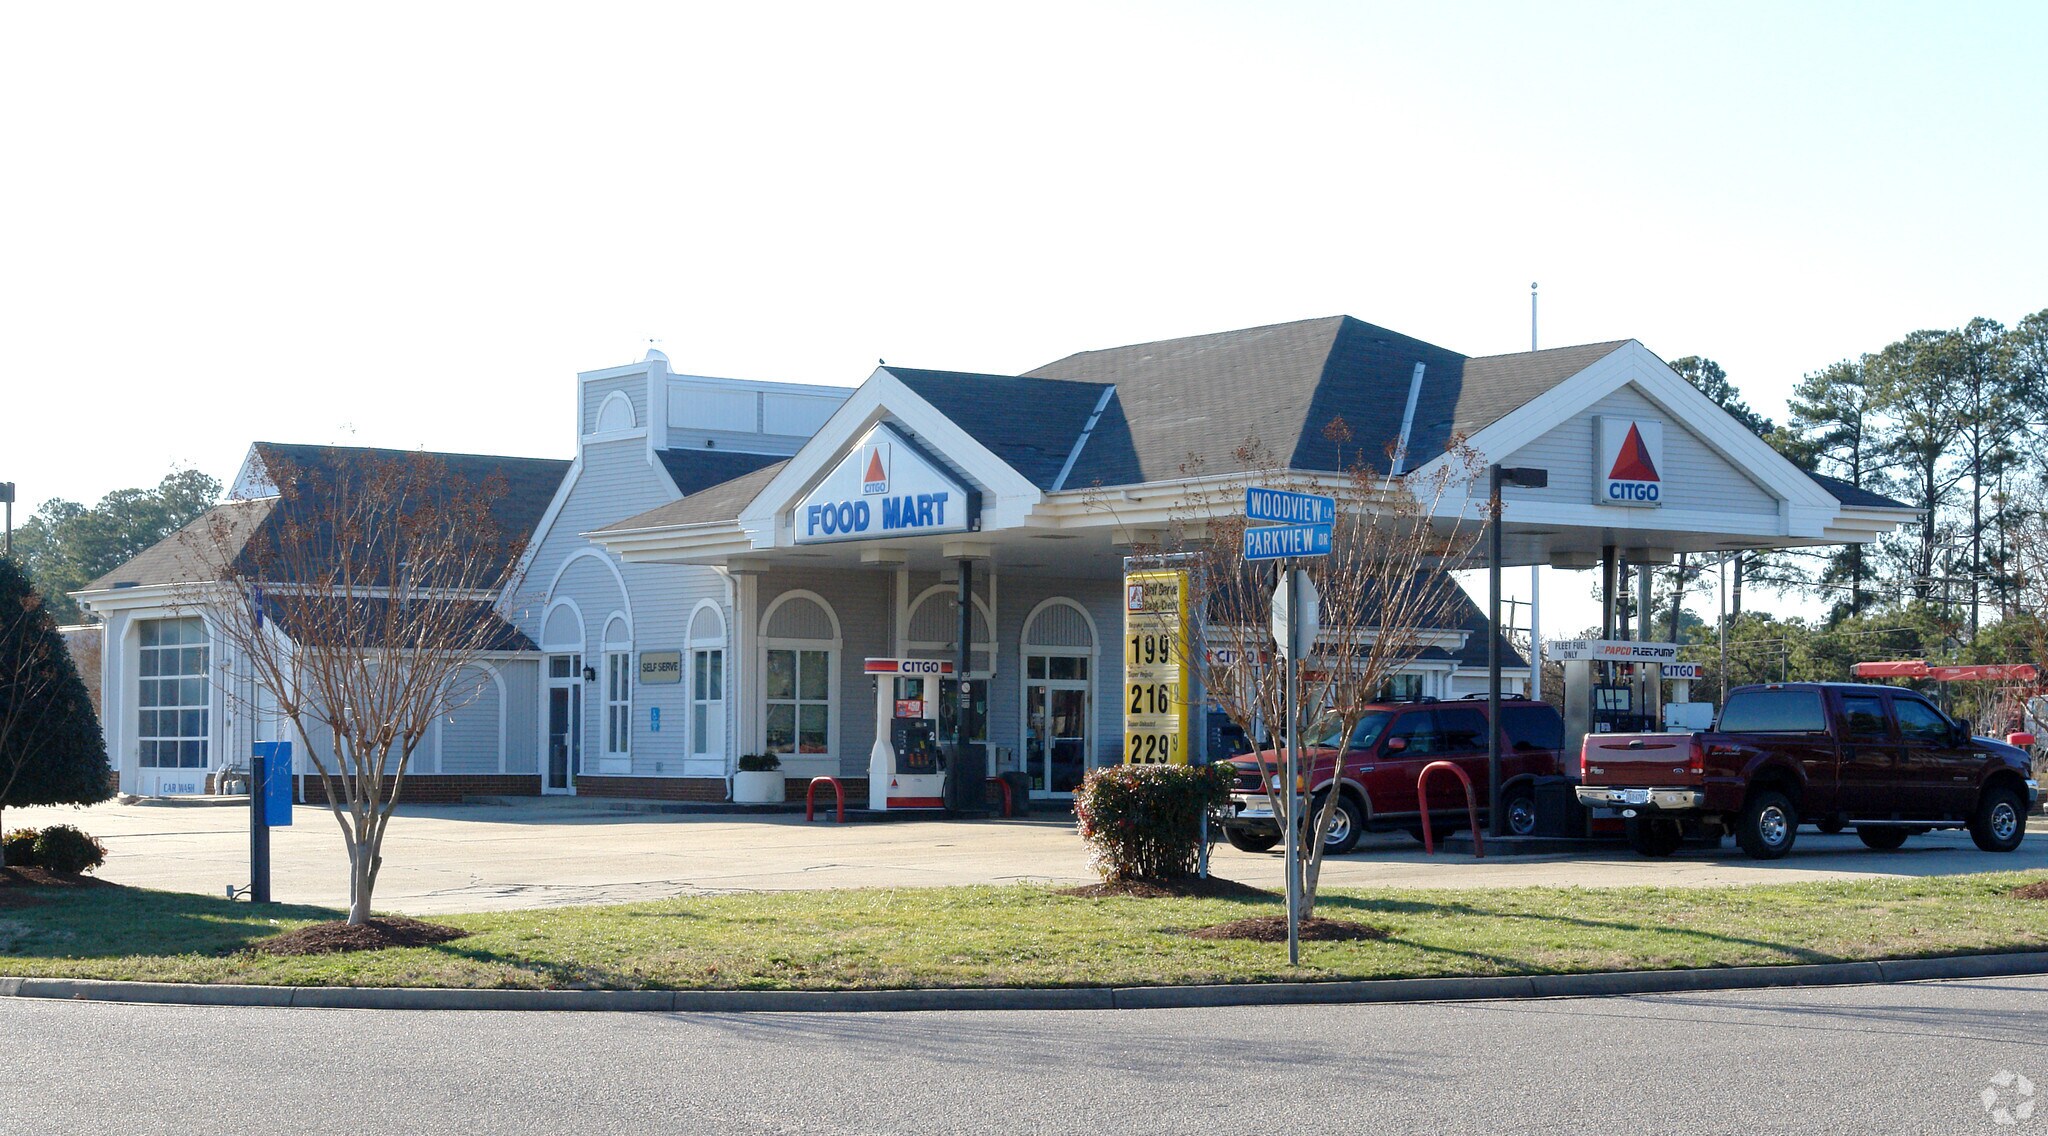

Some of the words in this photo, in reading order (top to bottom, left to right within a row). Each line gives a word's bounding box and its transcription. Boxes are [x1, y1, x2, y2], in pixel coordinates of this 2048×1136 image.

[864, 482, 886, 493] CITGO
[1609, 482, 1659, 501] CITGO
[1251, 491, 1322, 522] WOODVIEW
[1323, 506, 1333, 519] LA
[807, 500, 870, 536] FOOD
[882, 492, 948, 530] MART
[1247, 528, 1313, 555] PARKVIEW
[1318, 533, 1329, 546] DR
[1131, 634, 1169, 664] 199
[1554, 641, 1572, 650] FLEET
[1573, 641, 1588, 650] FUEL
[1604, 646, 1632, 656] PAPCO
[1563, 651, 1578, 659] ONLY
[642, 662, 657, 673] SELF
[658, 662, 678, 672] SERVE
[902, 661, 939, 673] CITGO
[1662, 665, 1693, 677] CITGO
[1131, 684, 1168, 714] 216
[929, 731, 935, 741] 2
[1130, 735, 1169, 764] 229
[163, 783, 176, 793] CAR
[178, 783, 195, 793] WASH
